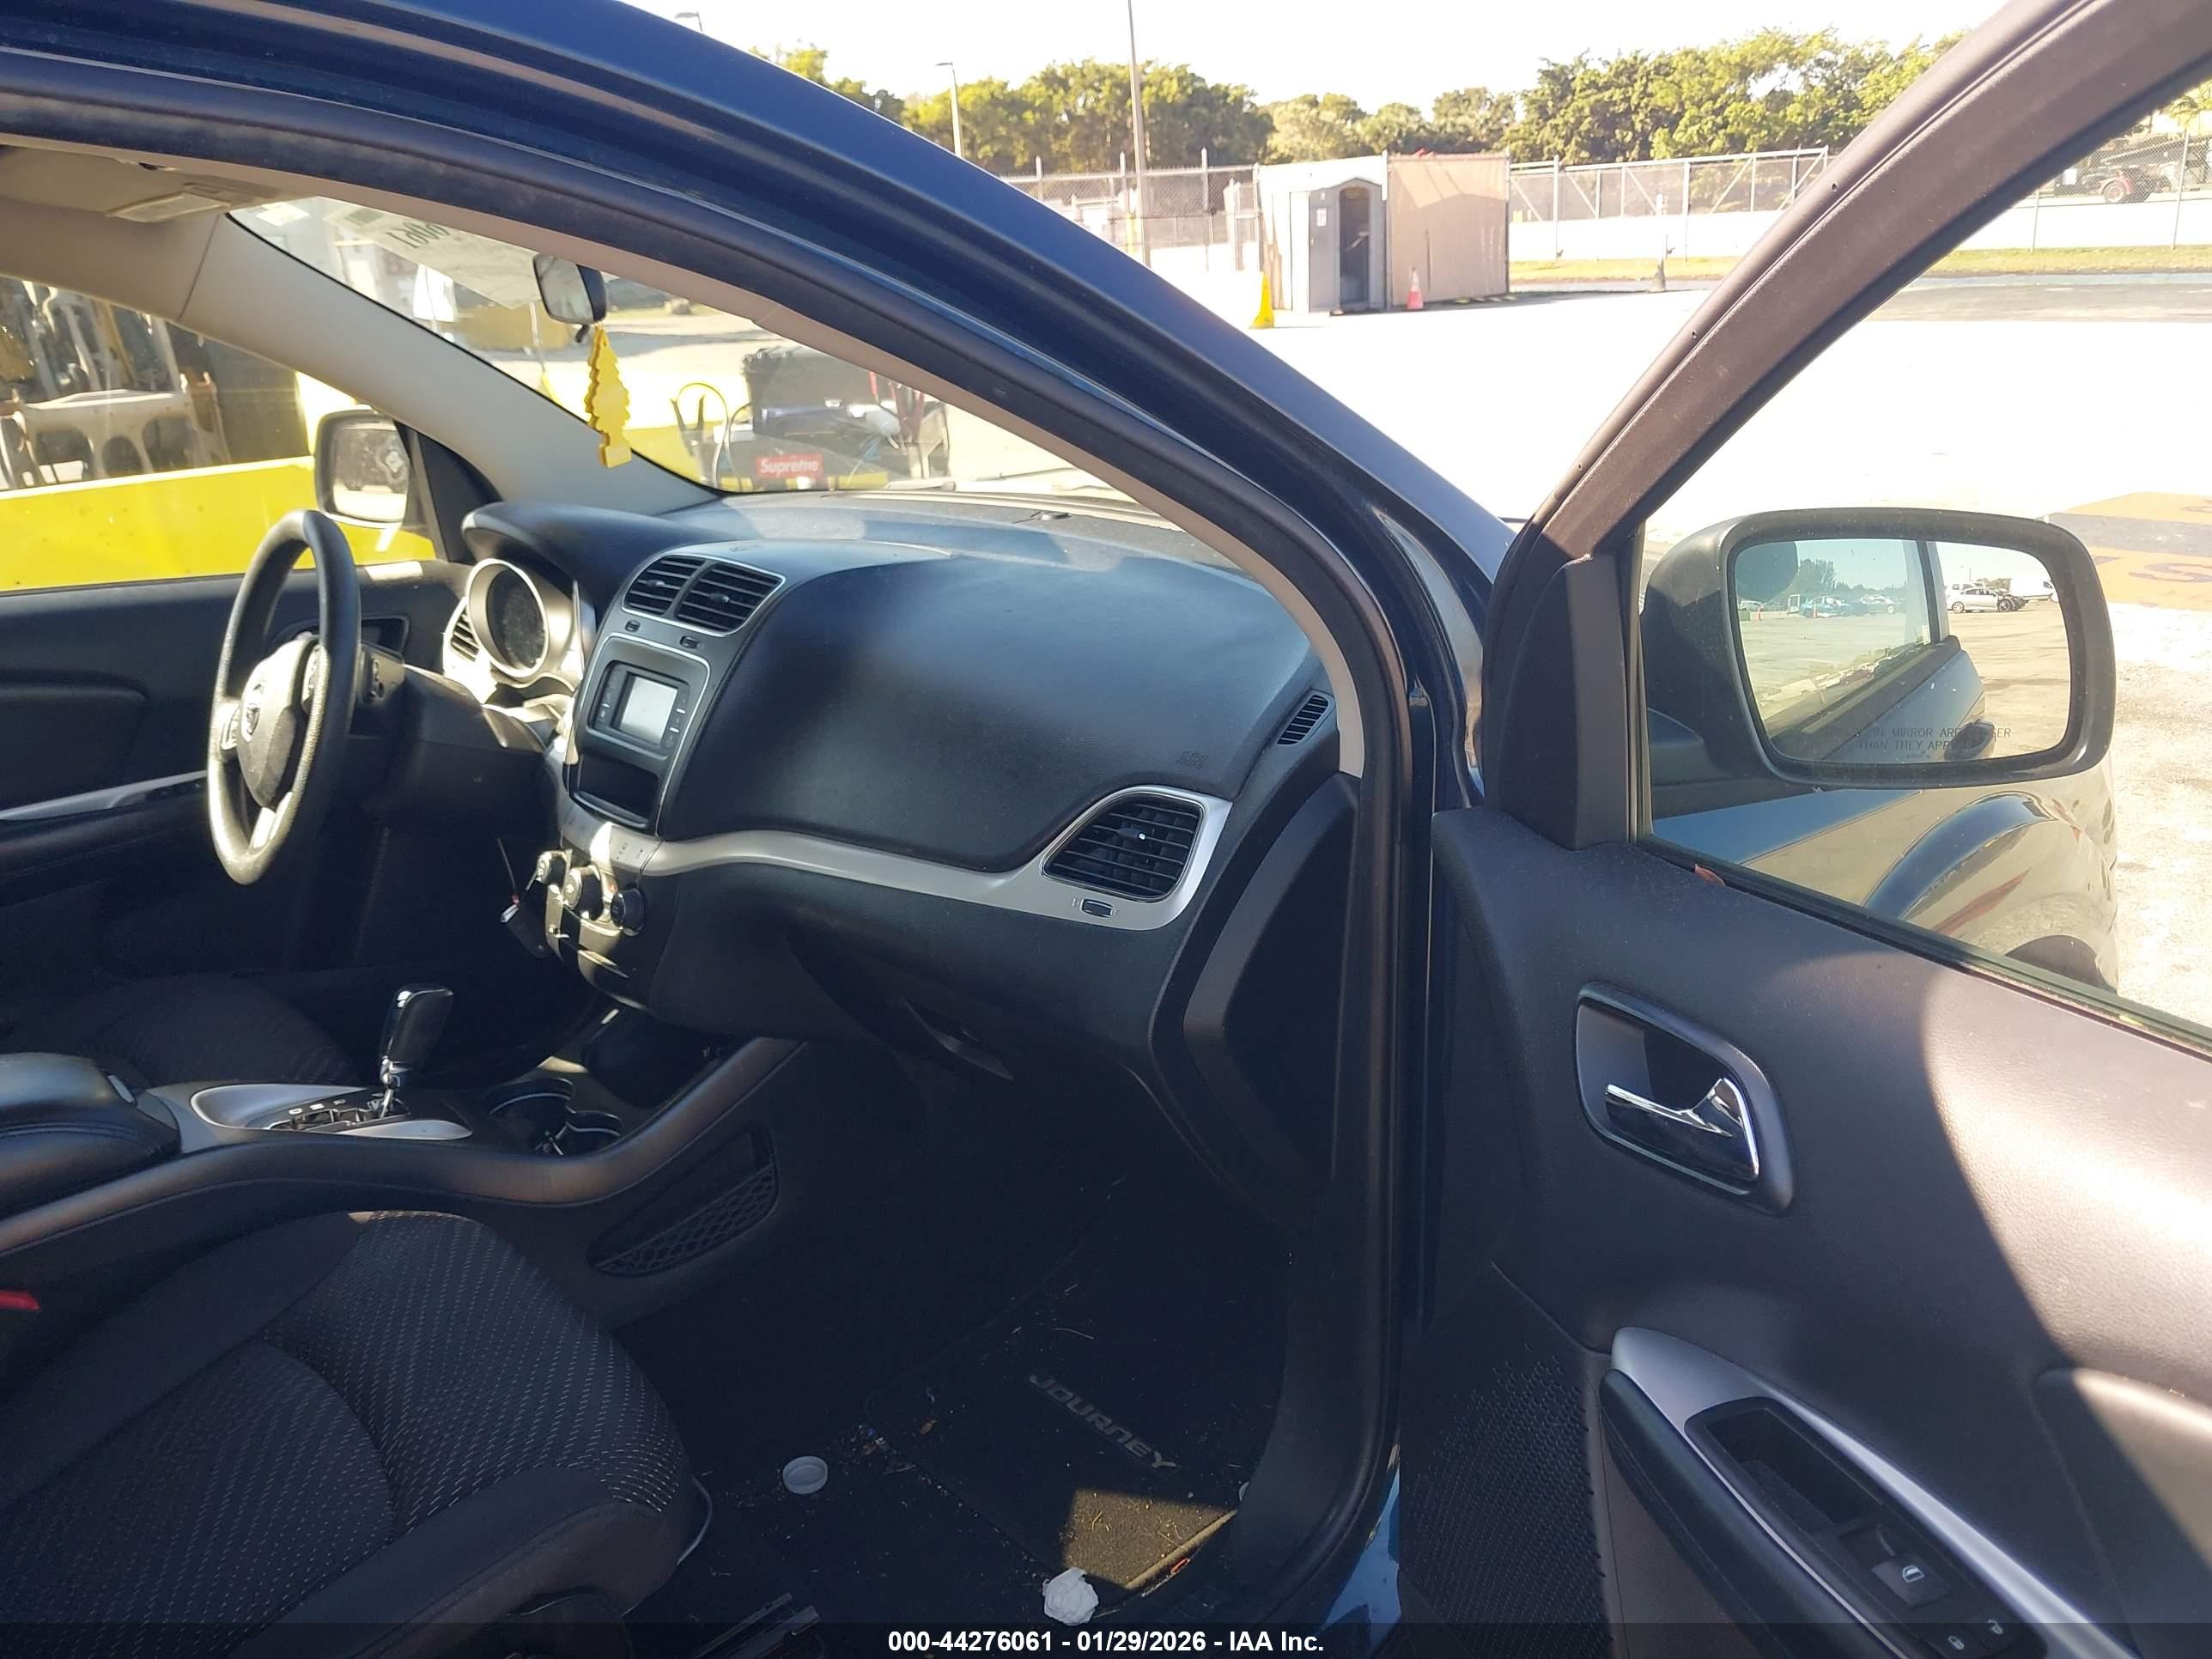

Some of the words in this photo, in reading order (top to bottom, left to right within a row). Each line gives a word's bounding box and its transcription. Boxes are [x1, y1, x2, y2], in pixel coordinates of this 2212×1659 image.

[760, 457, 820, 477] Supreme
[1892, 727, 1933, 738] MIRROR
[1859, 741, 1888, 750] THAN
[1894, 741, 1923, 750] THEY
[1029, 1374, 1177, 1468] JOURNEY
